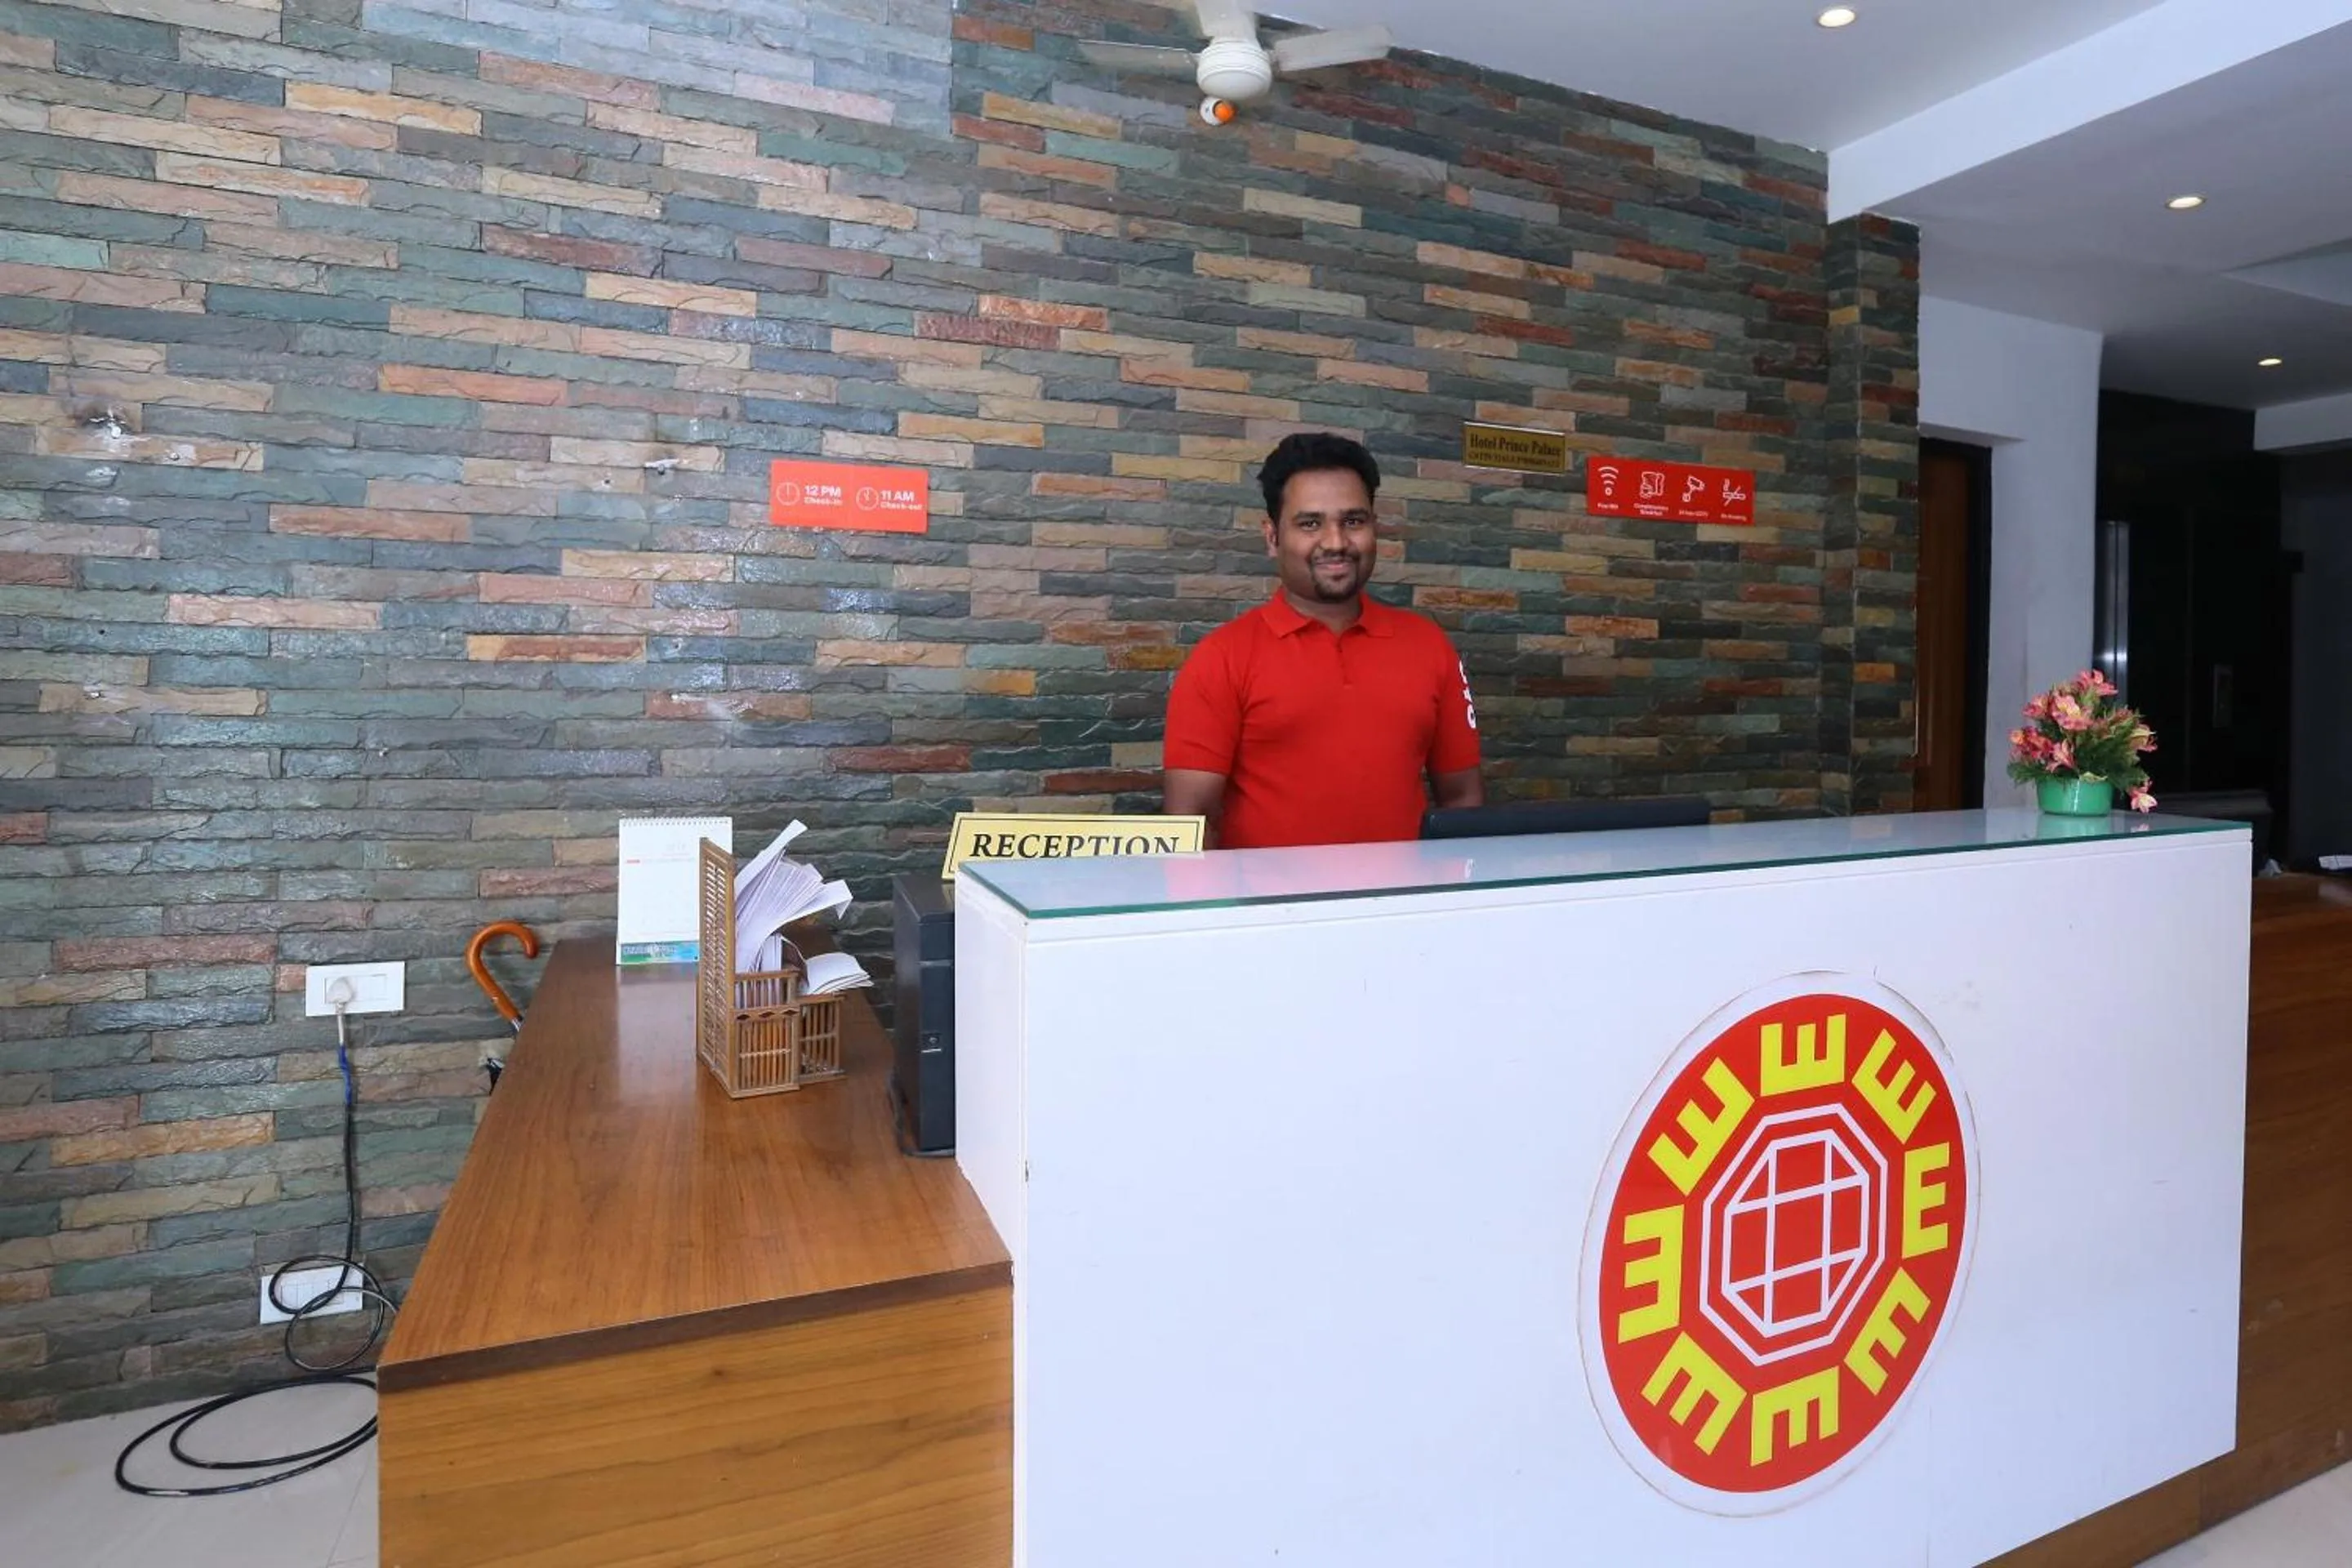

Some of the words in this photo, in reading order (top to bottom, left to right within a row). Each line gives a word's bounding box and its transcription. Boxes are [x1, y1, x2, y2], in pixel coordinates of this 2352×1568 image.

[1470, 434, 1496, 448] Hotel
[1499, 437, 1530, 452] Prince
[804, 484, 818, 496] 12
[821, 485, 841, 497] PM
[880, 489, 891, 501] 11
[893, 490, 915, 502] AM
[969, 833, 1180, 858] RECEPTION
